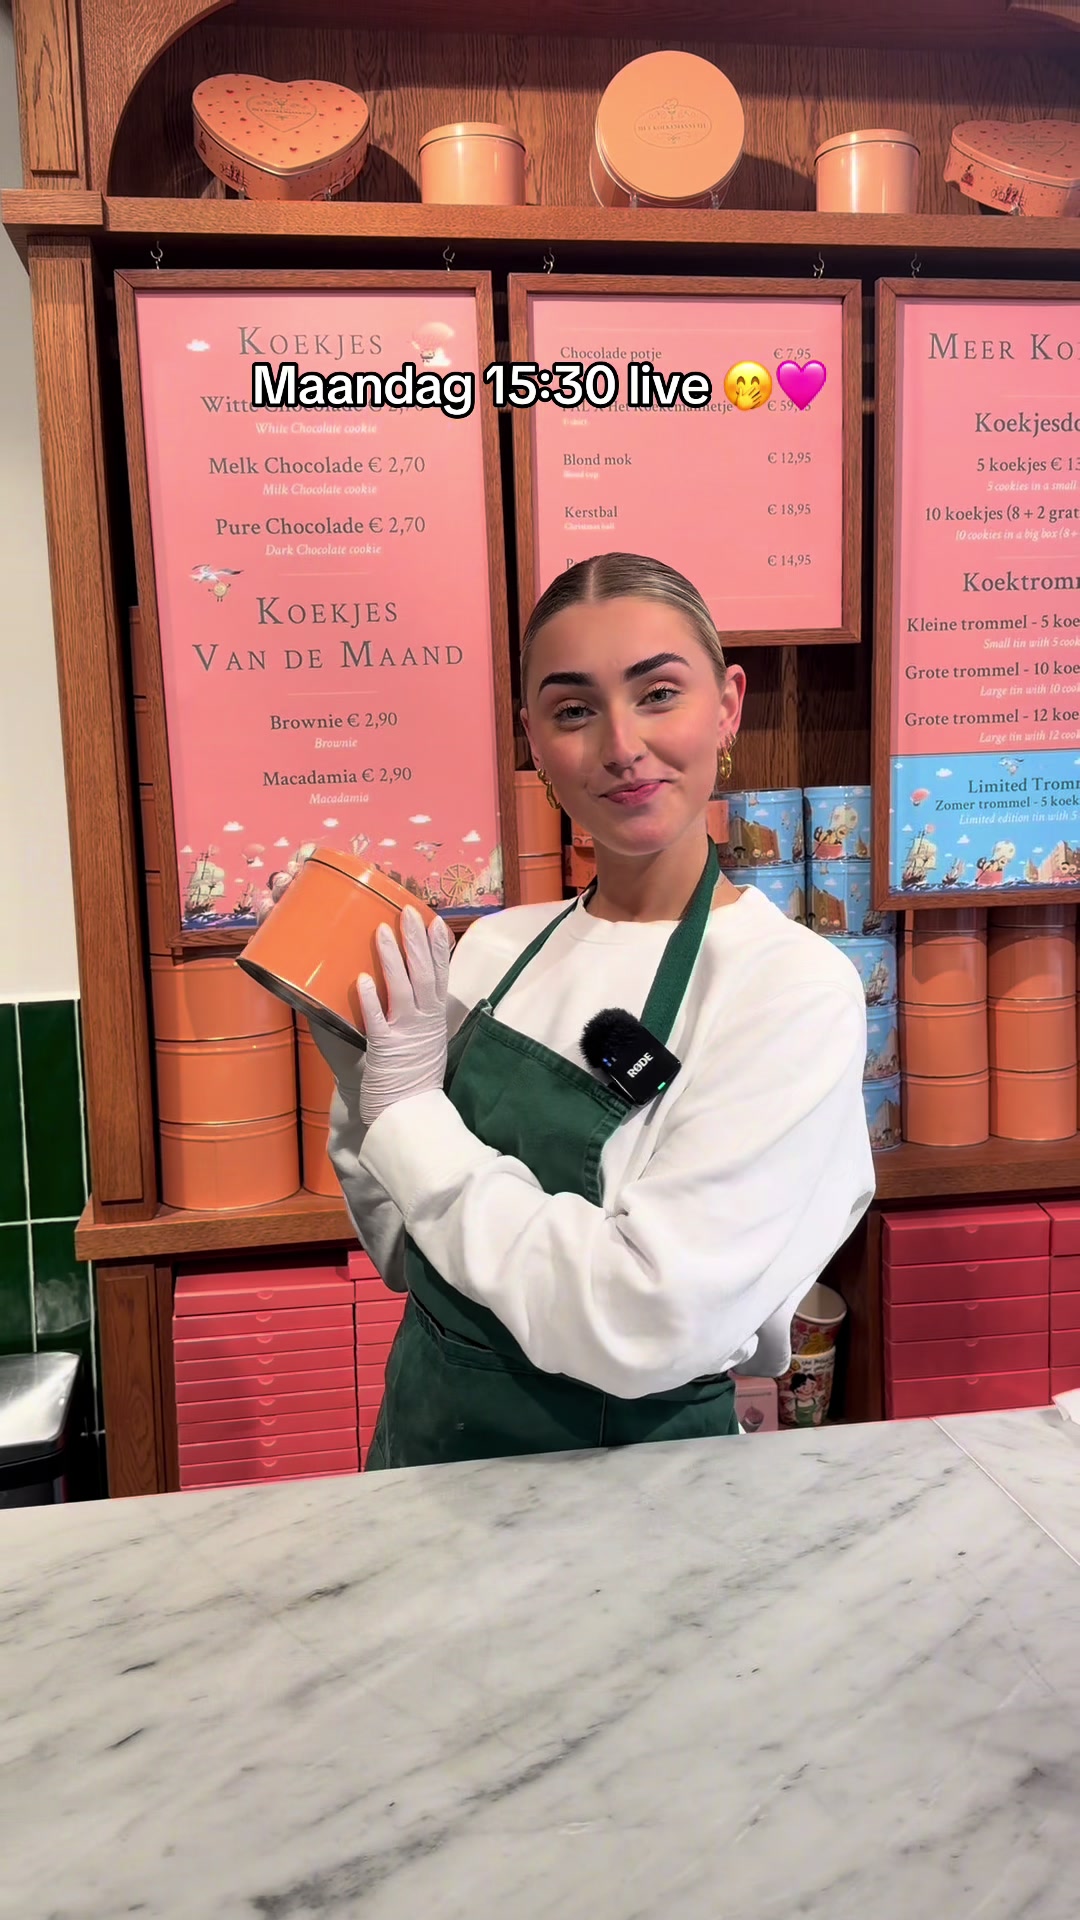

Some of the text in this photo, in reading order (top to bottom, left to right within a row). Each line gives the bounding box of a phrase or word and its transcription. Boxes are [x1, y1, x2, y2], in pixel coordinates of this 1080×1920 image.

[560, 347, 811, 361] Chocolade potje € 7,95
[768, 400, 776, 412] €
[256, 421, 377, 434] White Chocolate cookie
[208, 456, 426, 476] Melk Chocolade € 2,70
[564, 452, 812, 466] Blond mok € 12,95
[976, 458, 985, 472] 5
[989, 456, 1047, 475] koekjes
[1051, 456, 1062, 471] €
[262, 482, 377, 496] Milk Chocolate cookie
[994, 480, 1028, 491] cookies
[1031, 481, 1041, 491] in
[1051, 480, 1077, 490] small
[564, 504, 812, 518] Kerstbal € 18,95
[926, 507, 941, 521] 10
[945, 506, 1003, 524] koekjes
[1006, 504, 1020, 522] (8
[1024, 509, 1034, 519] +
[1037, 506, 1046, 519] 2
[216, 516, 426, 536] Pure Chocolade € 2,70
[968, 530, 1002, 540] cookies
[1004, 530, 1014, 540] in
[1024, 528, 1038, 541] big
[1041, 528, 1058, 538] box
[265, 543, 382, 556] Dark Chocolate cookie
[768, 554, 812, 568] € 14,95
[907, 618, 958, 632] Kleine
[961, 614, 1028, 630] trommel
[1040, 614, 1049, 628] 5
[984, 638, 1010, 649] Small
[1012, 638, 1026, 648] tin
[1029, 636, 1049, 648] with
[1052, 637, 1059, 647] 5
[905, 665, 949, 680] Grote
[953, 662, 1019, 678] trommel
[1034, 662, 1049, 675] 10
[980, 685, 1007, 699] Large
[1010, 685, 1022, 695] tin
[1026, 684, 1046, 694] with
[270, 712, 398, 730] Brownie € 2,90
[904, 712, 949, 726] Grote
[953, 709, 1019, 725] trommel
[1034, 708, 1048, 722] 12
[314, 738, 358, 749] Brownie
[979, 732, 1006, 745] Large
[1009, 732, 1022, 742] tin
[1024, 730, 1046, 741] with
[262, 767, 412, 787] Macadamia € 2,90
[968, 778, 1028, 794] Limited
[309, 792, 370, 805] Macadamia
[935, 800, 976, 811] Zomer
[979, 796, 1030, 810] trommel
[1041, 797, 1048, 807] 5
[959, 810, 1078, 825] Limited edition tin with 5
